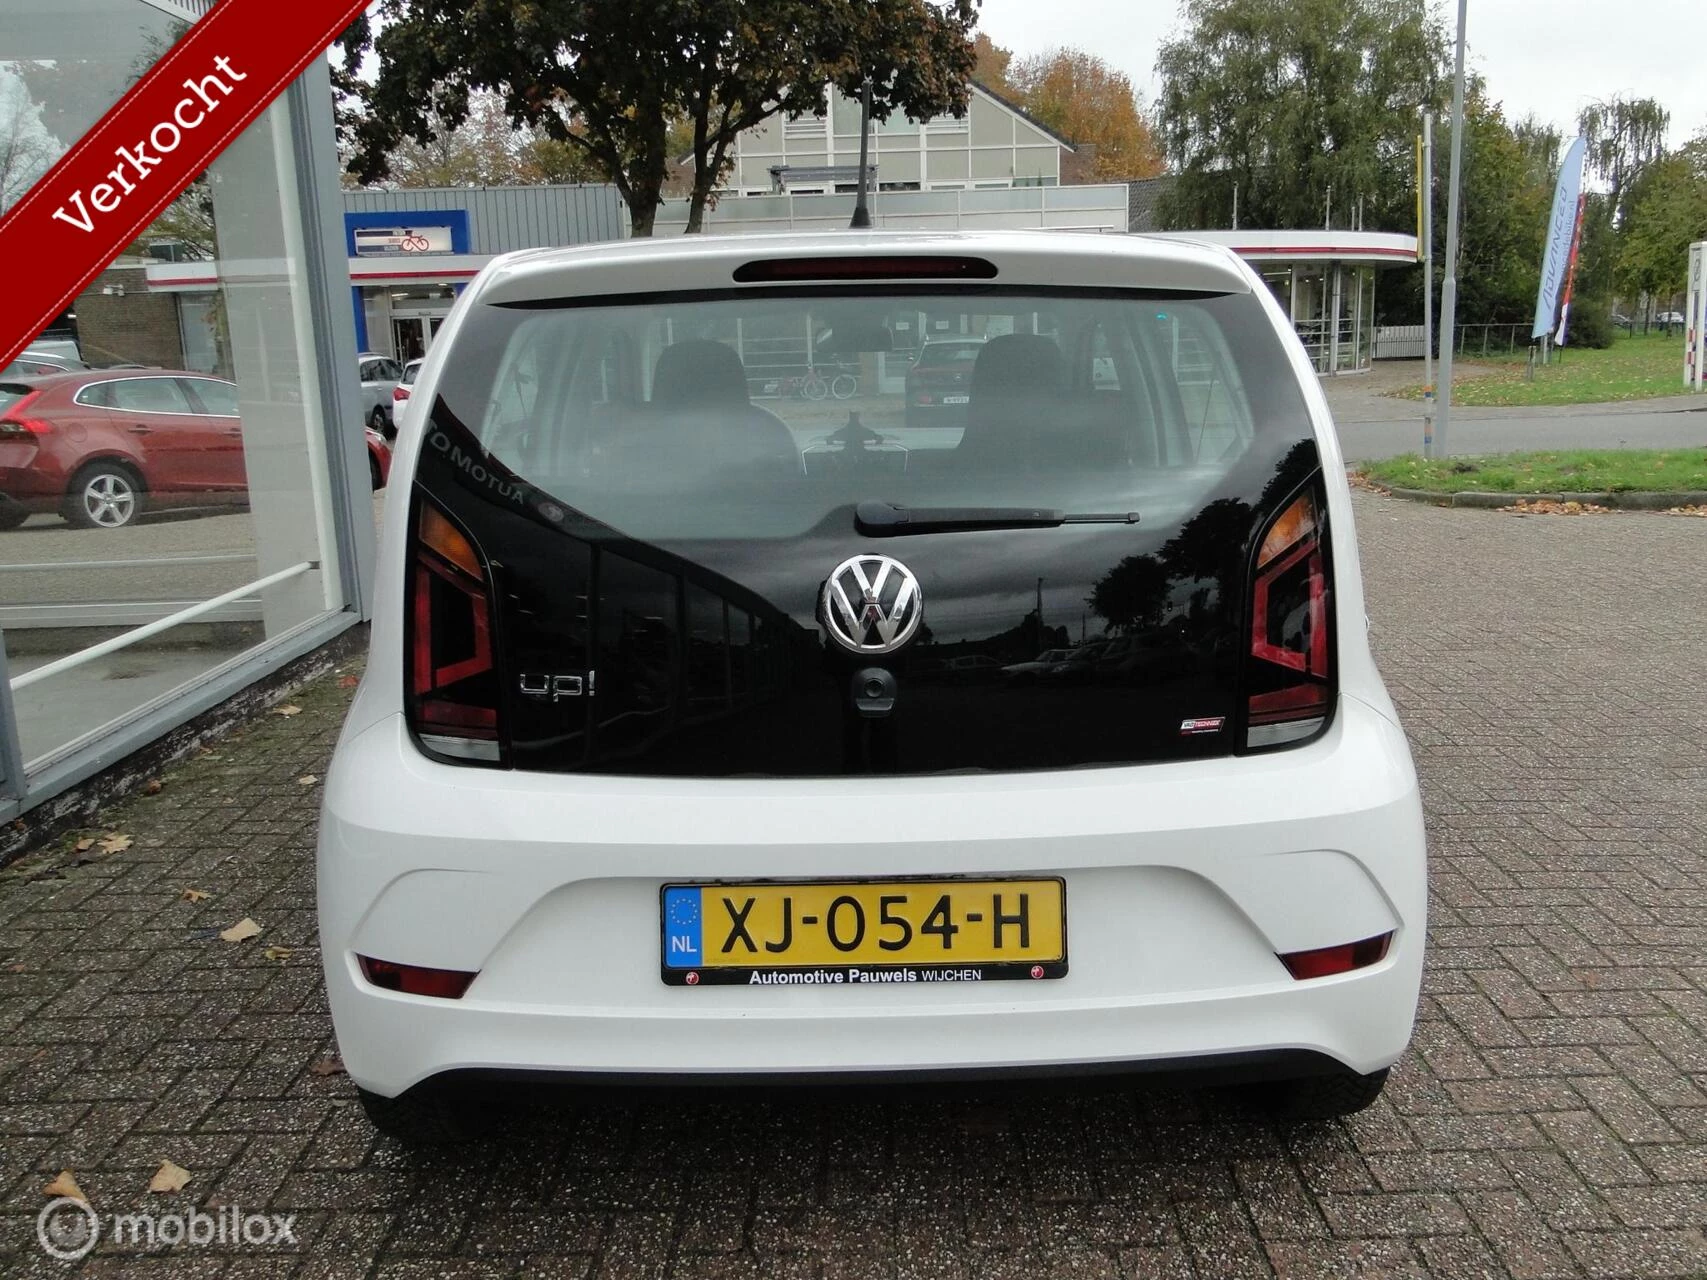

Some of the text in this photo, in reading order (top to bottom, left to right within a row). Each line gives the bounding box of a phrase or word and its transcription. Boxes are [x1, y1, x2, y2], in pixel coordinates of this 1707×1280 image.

[520, 670, 596, 702] up!
[720, 894, 1030, 953] XJ-054-H
[671, 935, 698, 953] NL
[749, 968, 983, 985] Automotive Pauwels WIJCHEN
